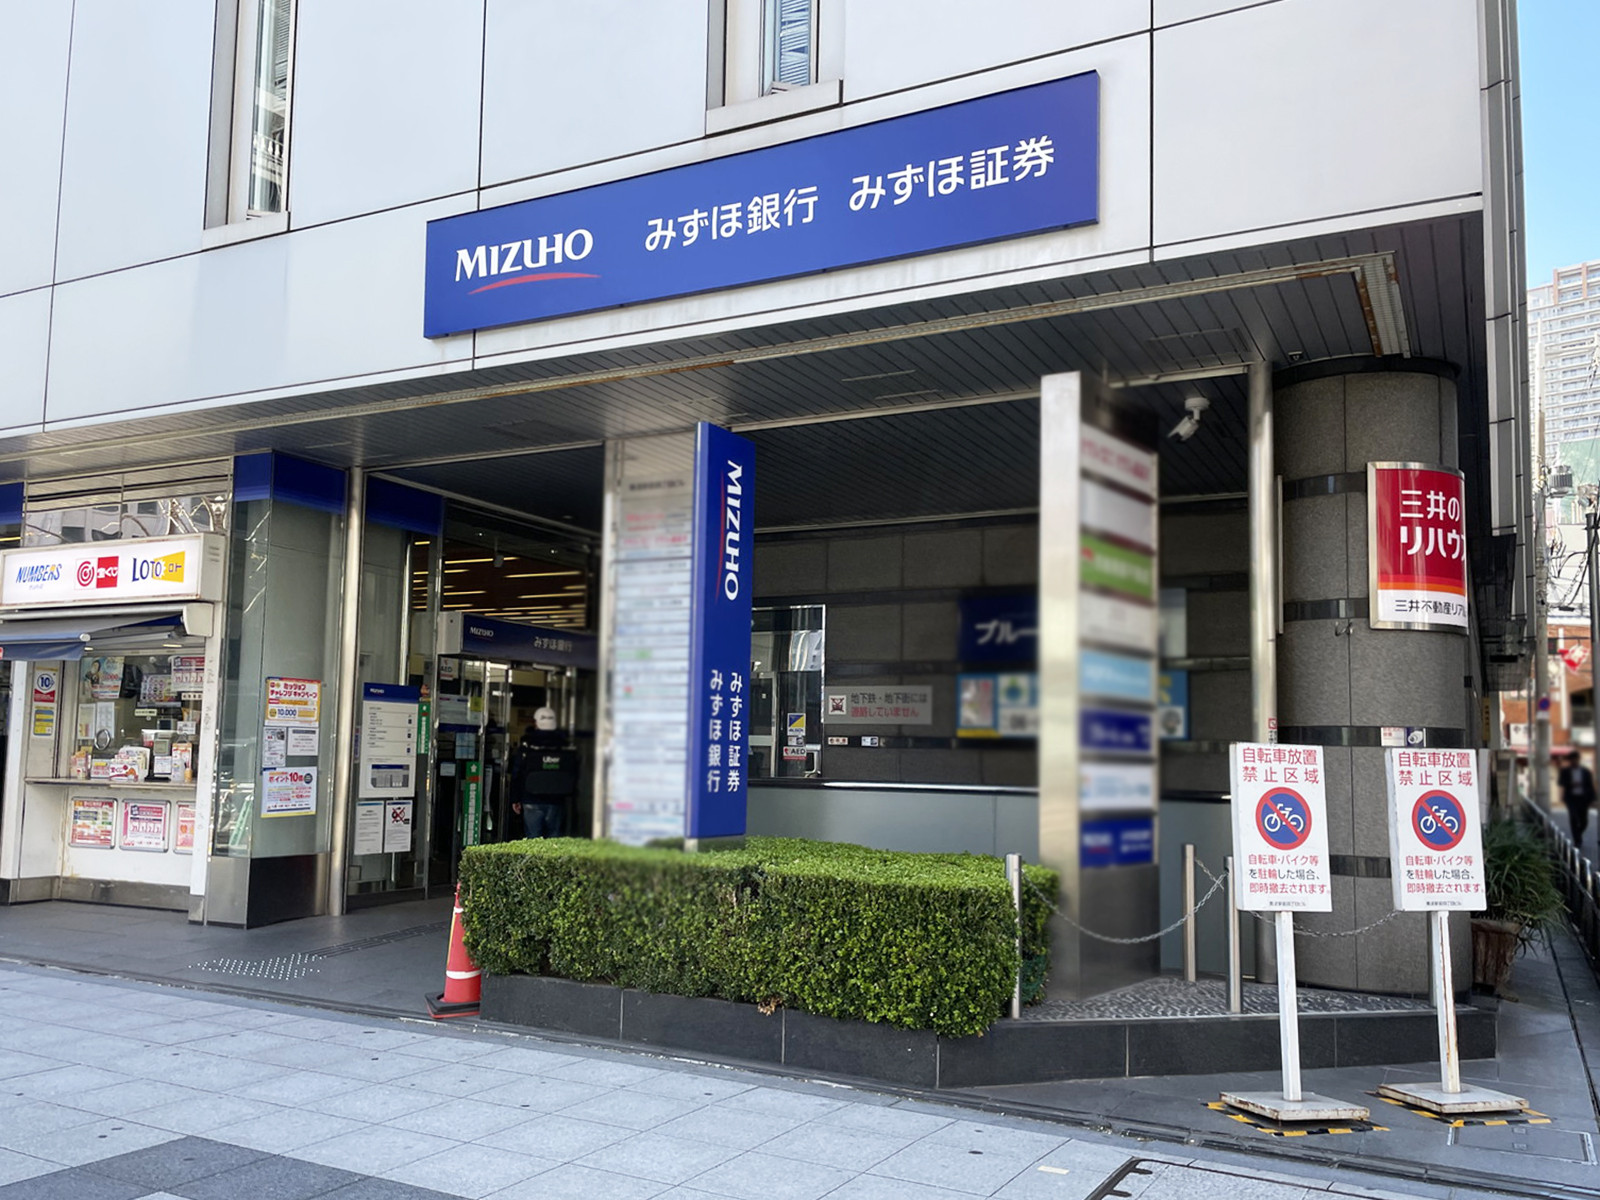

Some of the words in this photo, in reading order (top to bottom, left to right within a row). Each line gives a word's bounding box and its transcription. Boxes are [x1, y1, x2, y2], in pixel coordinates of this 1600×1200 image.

[645, 186, 818, 251] みずほ銀行
[849, 135, 1055, 212] みずほ証券
[455, 229, 593, 281] MIZUHO
[1400, 490, 1460, 521] 三井の
[725, 460, 742, 600] MIZUHO
[16, 563, 62, 583] NUMBERS
[132, 557, 164, 582] LOTO
[469, 626, 494, 637] MIZUHO
[707, 669, 723, 792] みずほ銀行
[727, 672, 743, 792] みずほ証券
[1243, 747, 1318, 766] 自転車放置
[1398, 752, 1471, 768] 自転車放置
[1243, 766, 1319, 784] 禁止区域
[1398, 770, 1473, 786] 禁止区域
[1248, 854, 1319, 866] 自転車・バイク等
[1405, 856, 1474, 867] 自転車・バイク等
[1249, 869, 1320, 880] を駐輪した場合、
[1406, 869, 1475, 880] を駐輪した場合、
